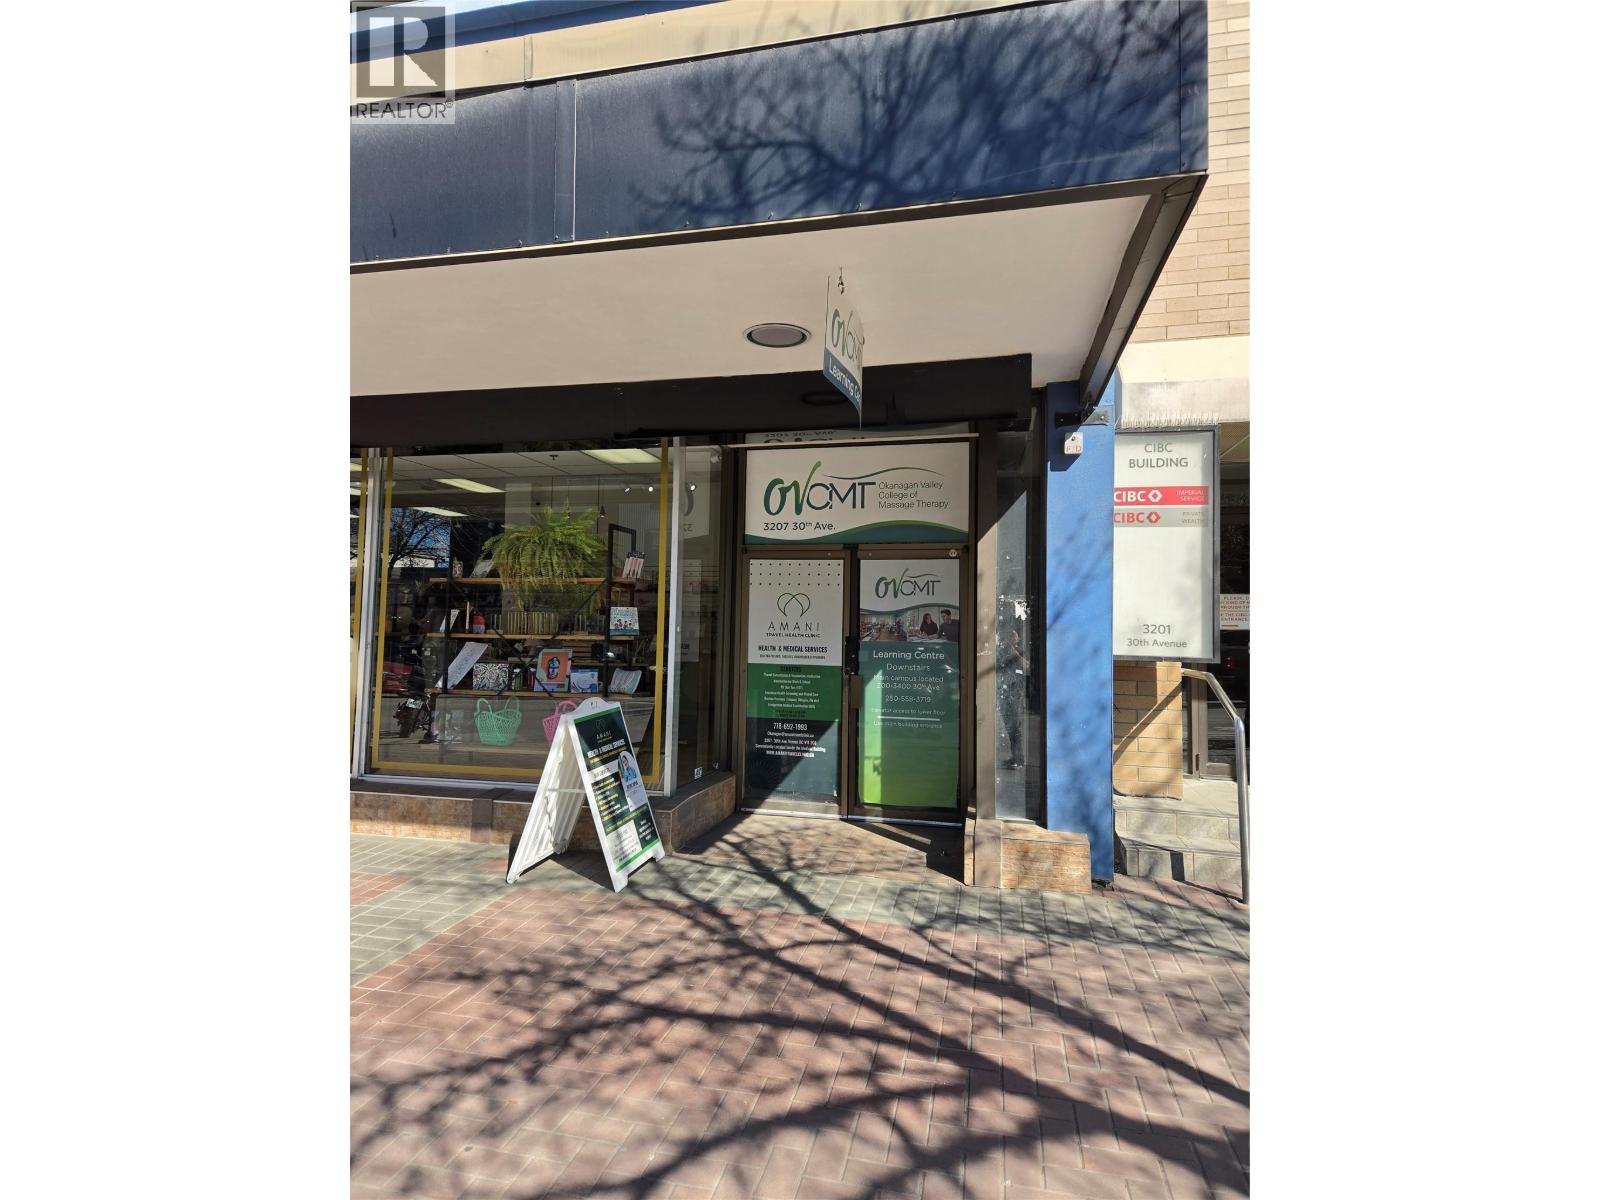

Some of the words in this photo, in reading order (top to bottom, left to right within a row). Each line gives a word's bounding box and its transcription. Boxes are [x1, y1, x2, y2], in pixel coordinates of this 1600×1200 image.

[829, 357, 854, 396] Learning
[1144, 442, 1173, 453] CIBC
[1128, 458, 1189, 468] BUILDING
[763, 460, 876, 517] OVCMT
[878, 481, 919, 491] Okanagan
[920, 480, 943, 490] Valley
[878, 490, 908, 501] College
[910, 490, 918, 498] of
[1113, 490, 1146, 502] CIBC
[878, 500, 915, 511] Massage
[916, 499, 949, 511] Therapy
[1113, 512, 1145, 524] CIBC
[763, 522, 789, 532] 3207
[792, 520, 813, 531] 30th
[814, 520, 836, 532] Ave.
[875, 567, 942, 599] OVCMT
[768, 621, 820, 632] AMANI
[1142, 624, 1171, 635] 3201
[1127, 638, 1149, 647] 30th
[1152, 639, 1188, 648] Avenue
[758, 644, 776, 652] HEALTH
[804, 646, 828, 654] SERVICES
[873, 650, 912, 660] Learning
[914, 650, 945, 660] Centre
[918, 675, 944, 683] located
